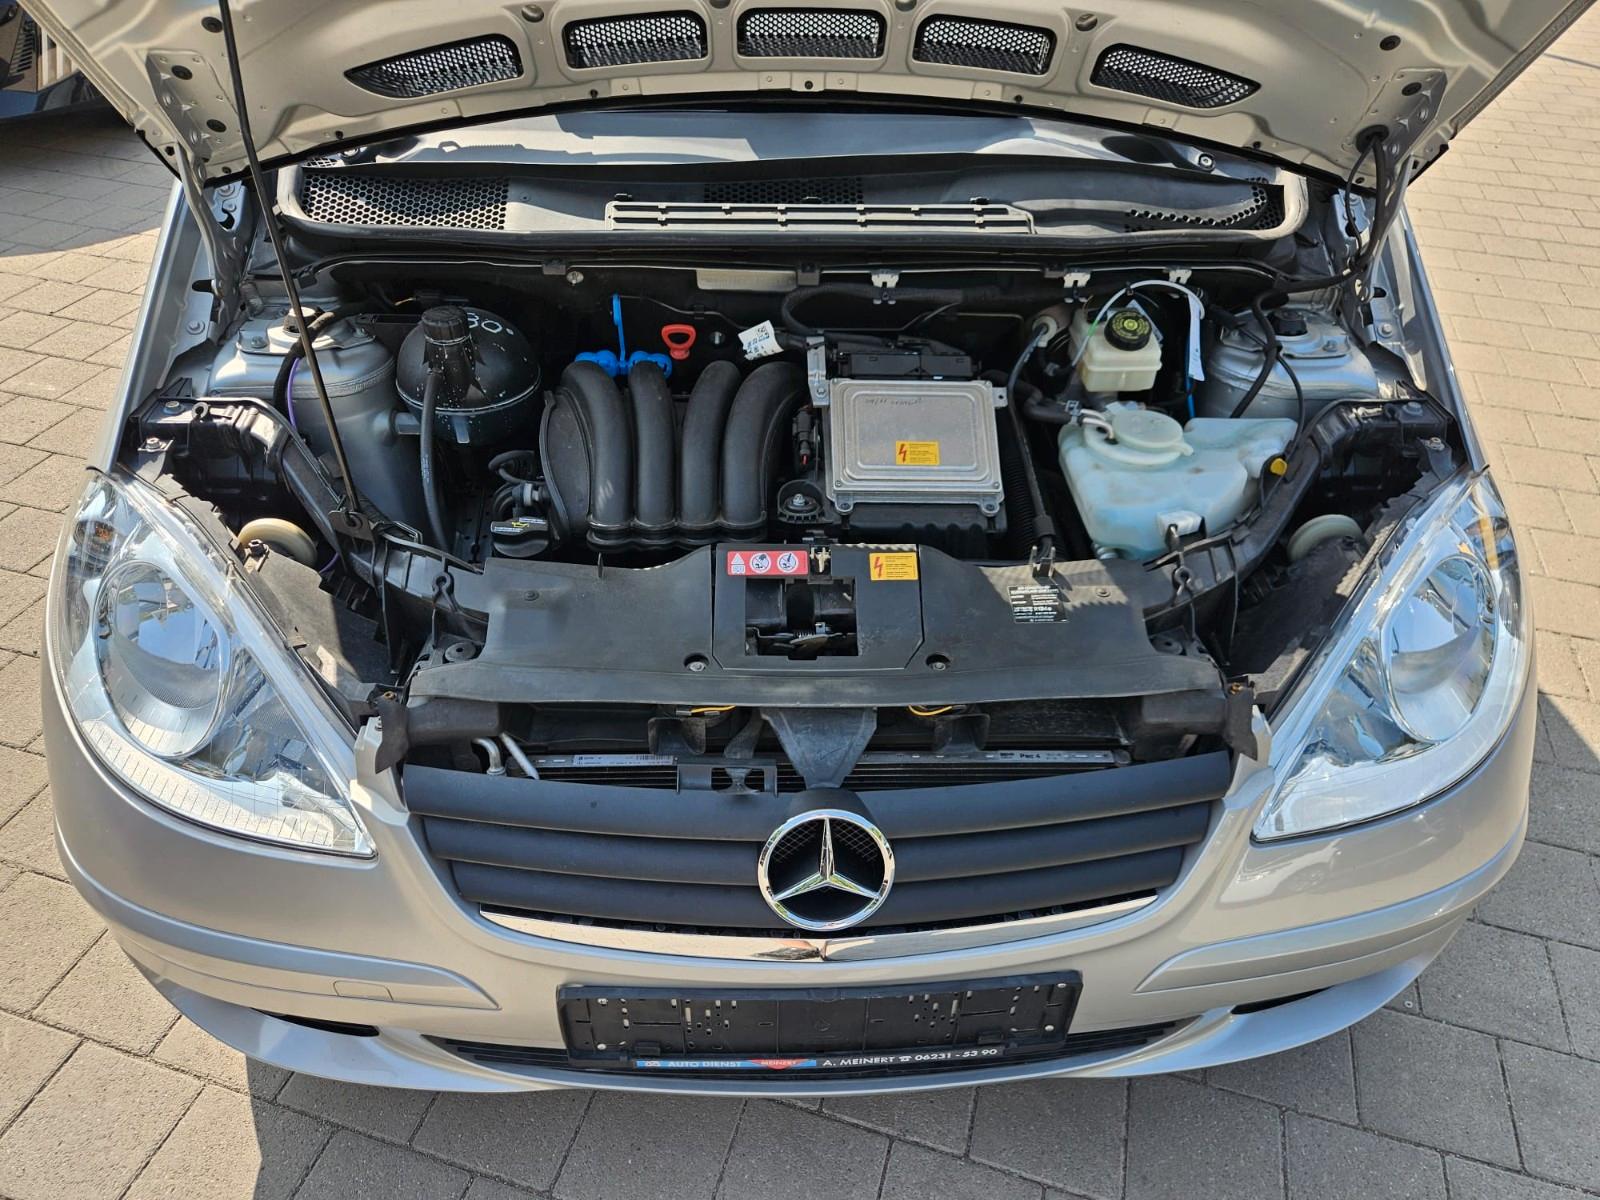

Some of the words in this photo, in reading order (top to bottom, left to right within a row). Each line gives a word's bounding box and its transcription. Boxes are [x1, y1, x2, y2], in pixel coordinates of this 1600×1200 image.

[840, 1056, 895, 1066] MEINERT
[914, 1052, 951, 1061] 06231
[962, 1050, 978, 1058] 53
[981, 1048, 998, 1056] 90
